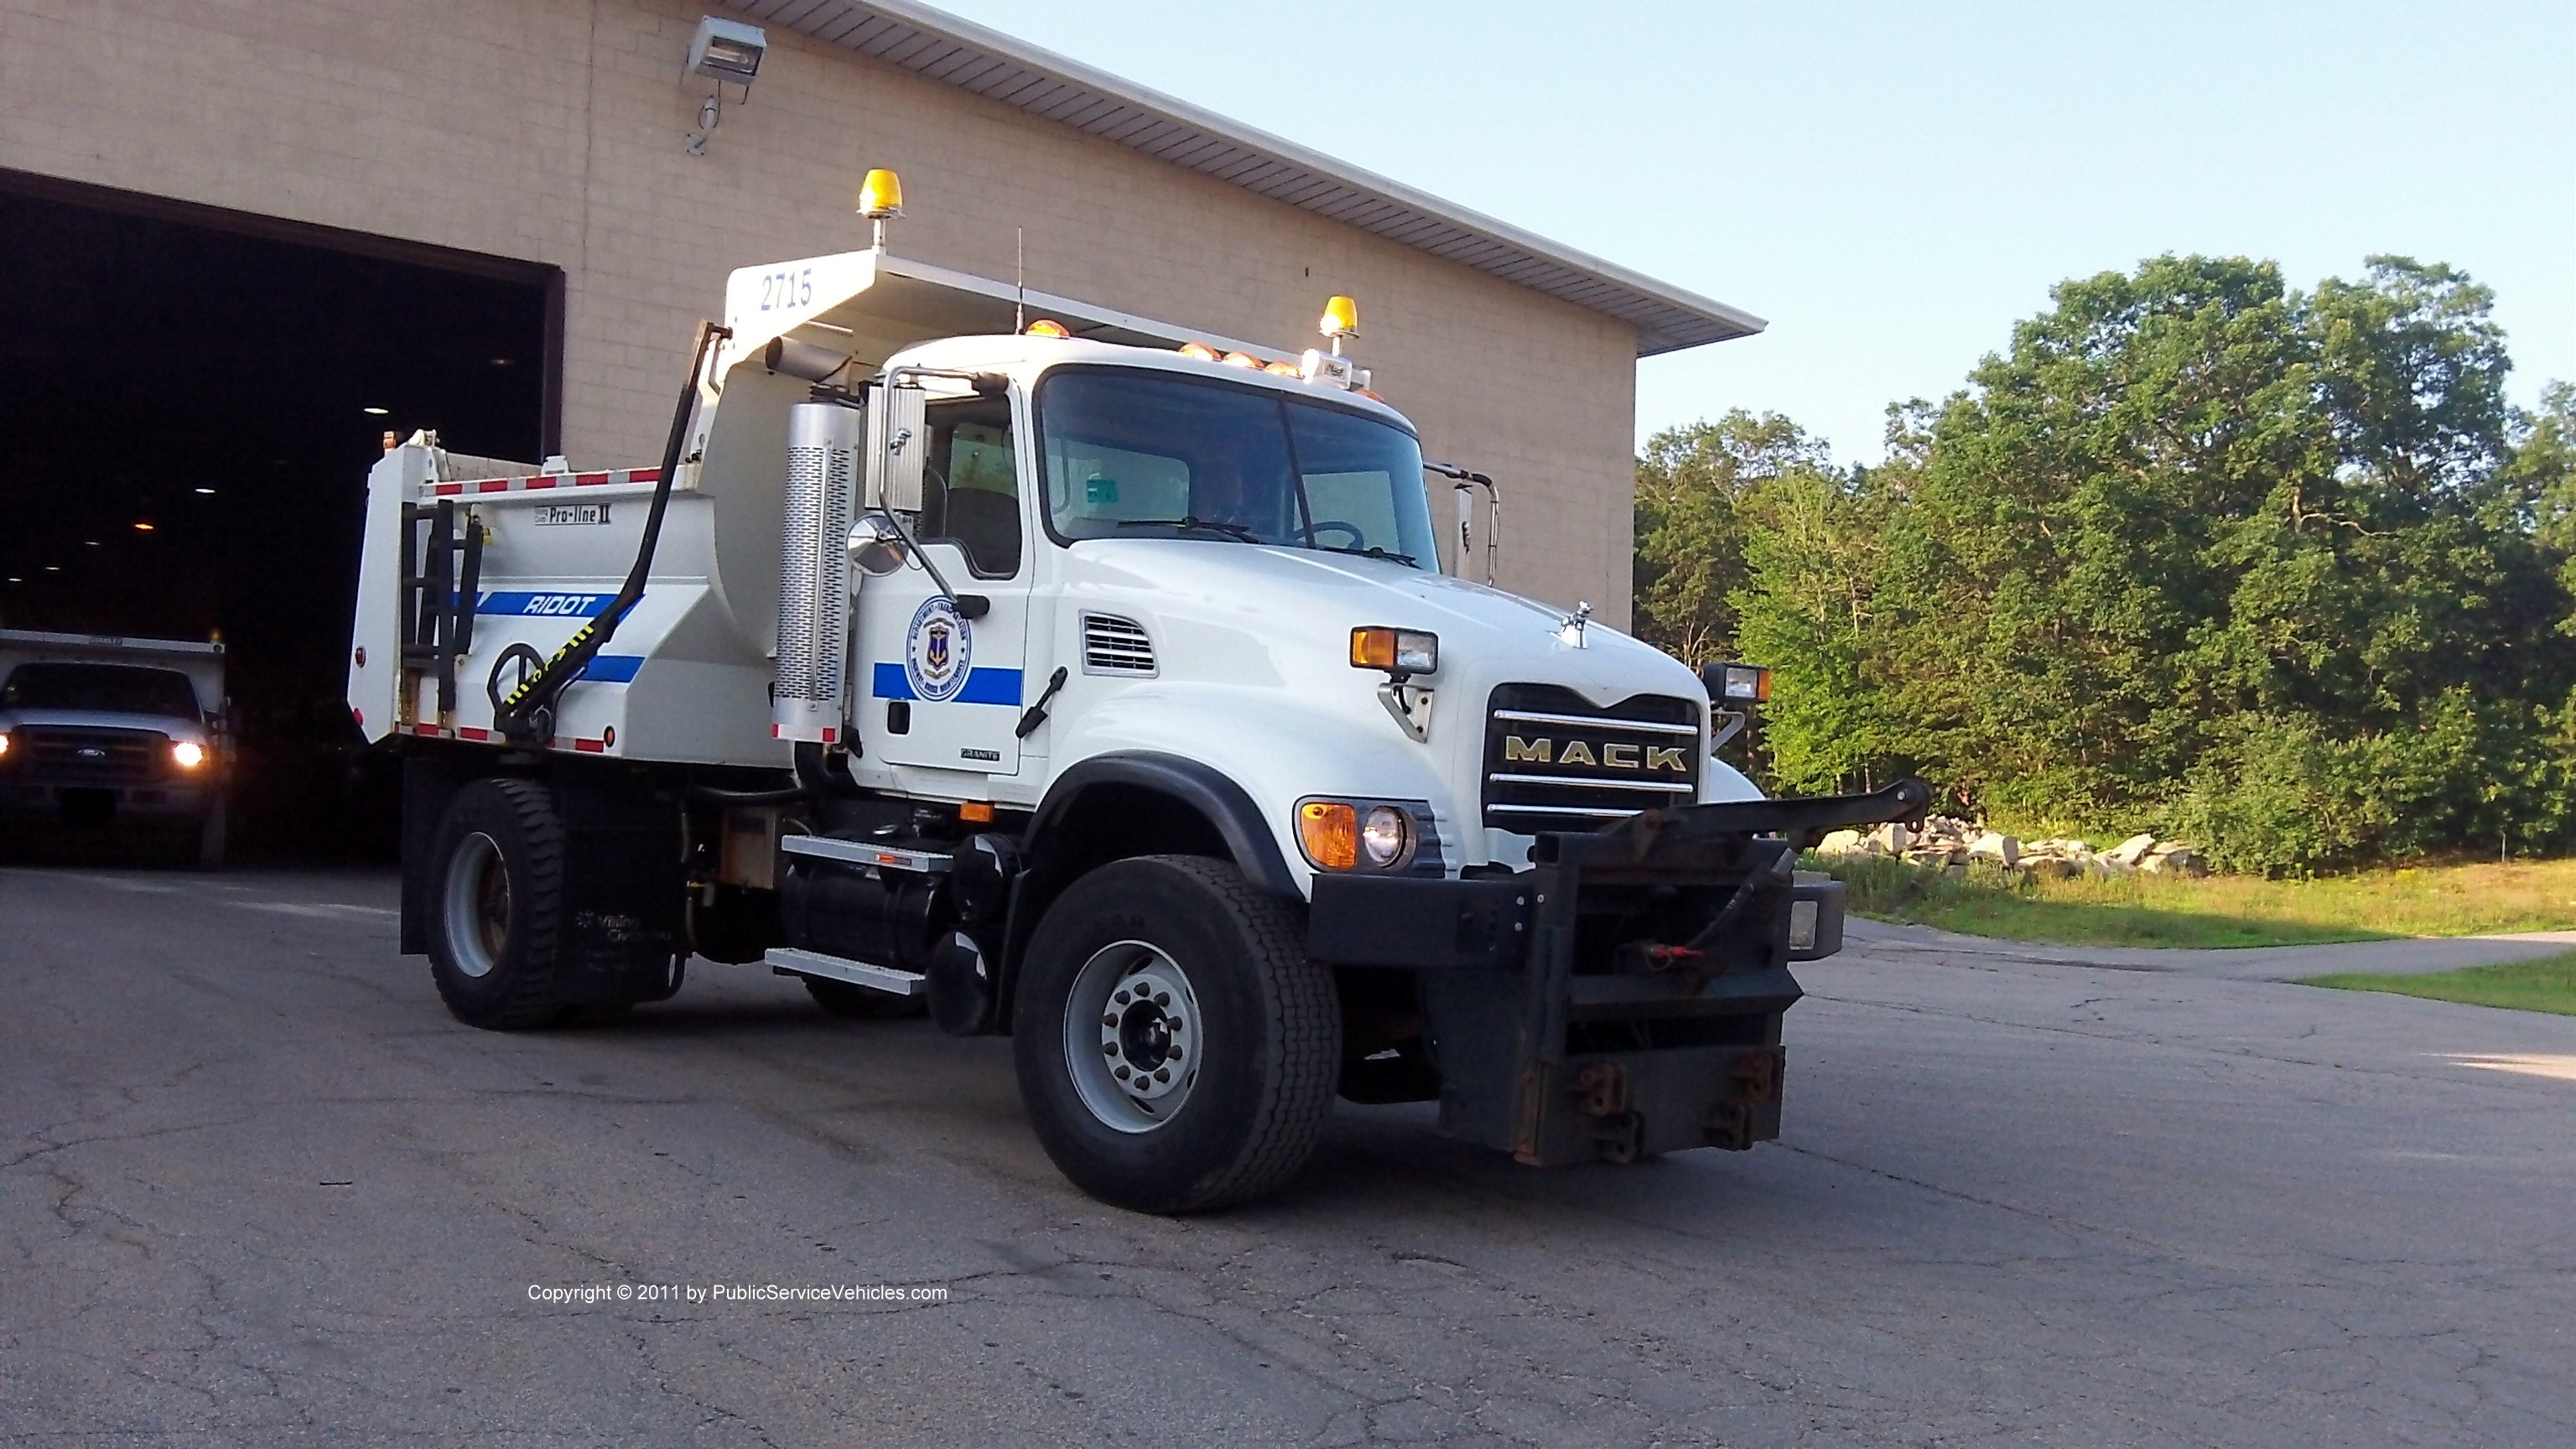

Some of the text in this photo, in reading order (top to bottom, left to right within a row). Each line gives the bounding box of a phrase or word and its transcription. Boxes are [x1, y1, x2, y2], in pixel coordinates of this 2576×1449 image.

[761, 268, 812, 311] 2715
[522, 595, 597, 615] RIDOT
[1505, 735, 1687, 772] MACK
